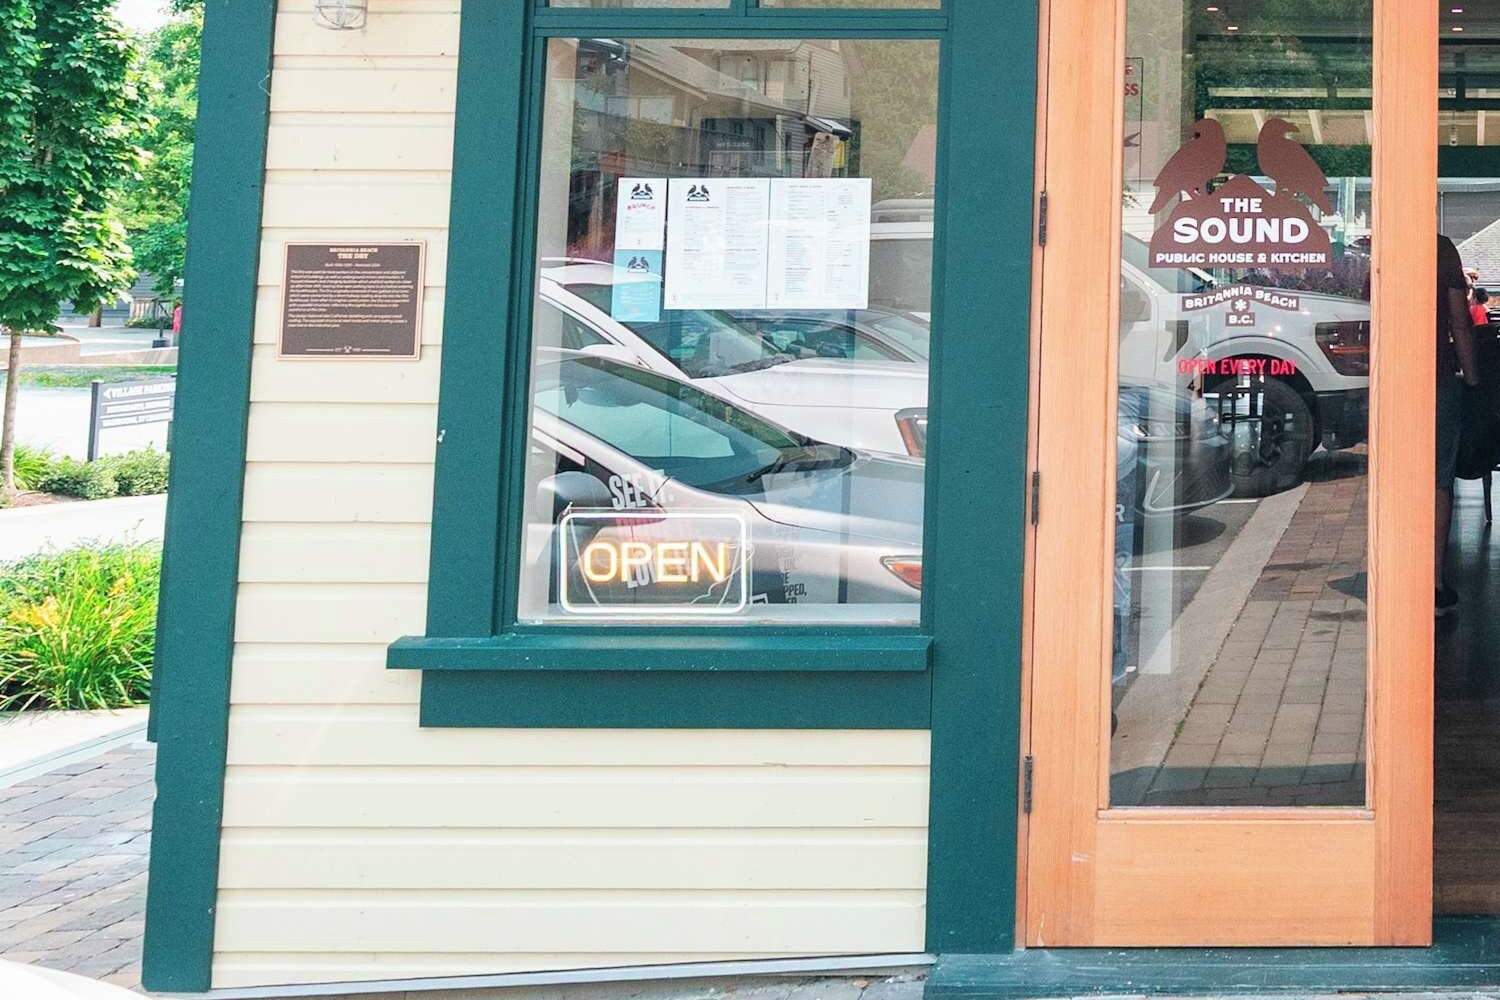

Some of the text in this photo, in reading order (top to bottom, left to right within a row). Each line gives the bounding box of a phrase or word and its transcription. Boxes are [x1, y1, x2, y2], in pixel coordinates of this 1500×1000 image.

[1219, 197, 1263, 213] THE
[1173, 216, 1310, 244] SOUND
[1155, 252, 1327, 264] PUBLIC HOUSE & KITCHEN
[1184, 285, 1298, 309] BRITANNIA BEACH
[1228, 314, 1254, 324] B.C.
[1177, 358, 1297, 375] OPEN EVERY DAY
[582, 540, 730, 584] OPEN
